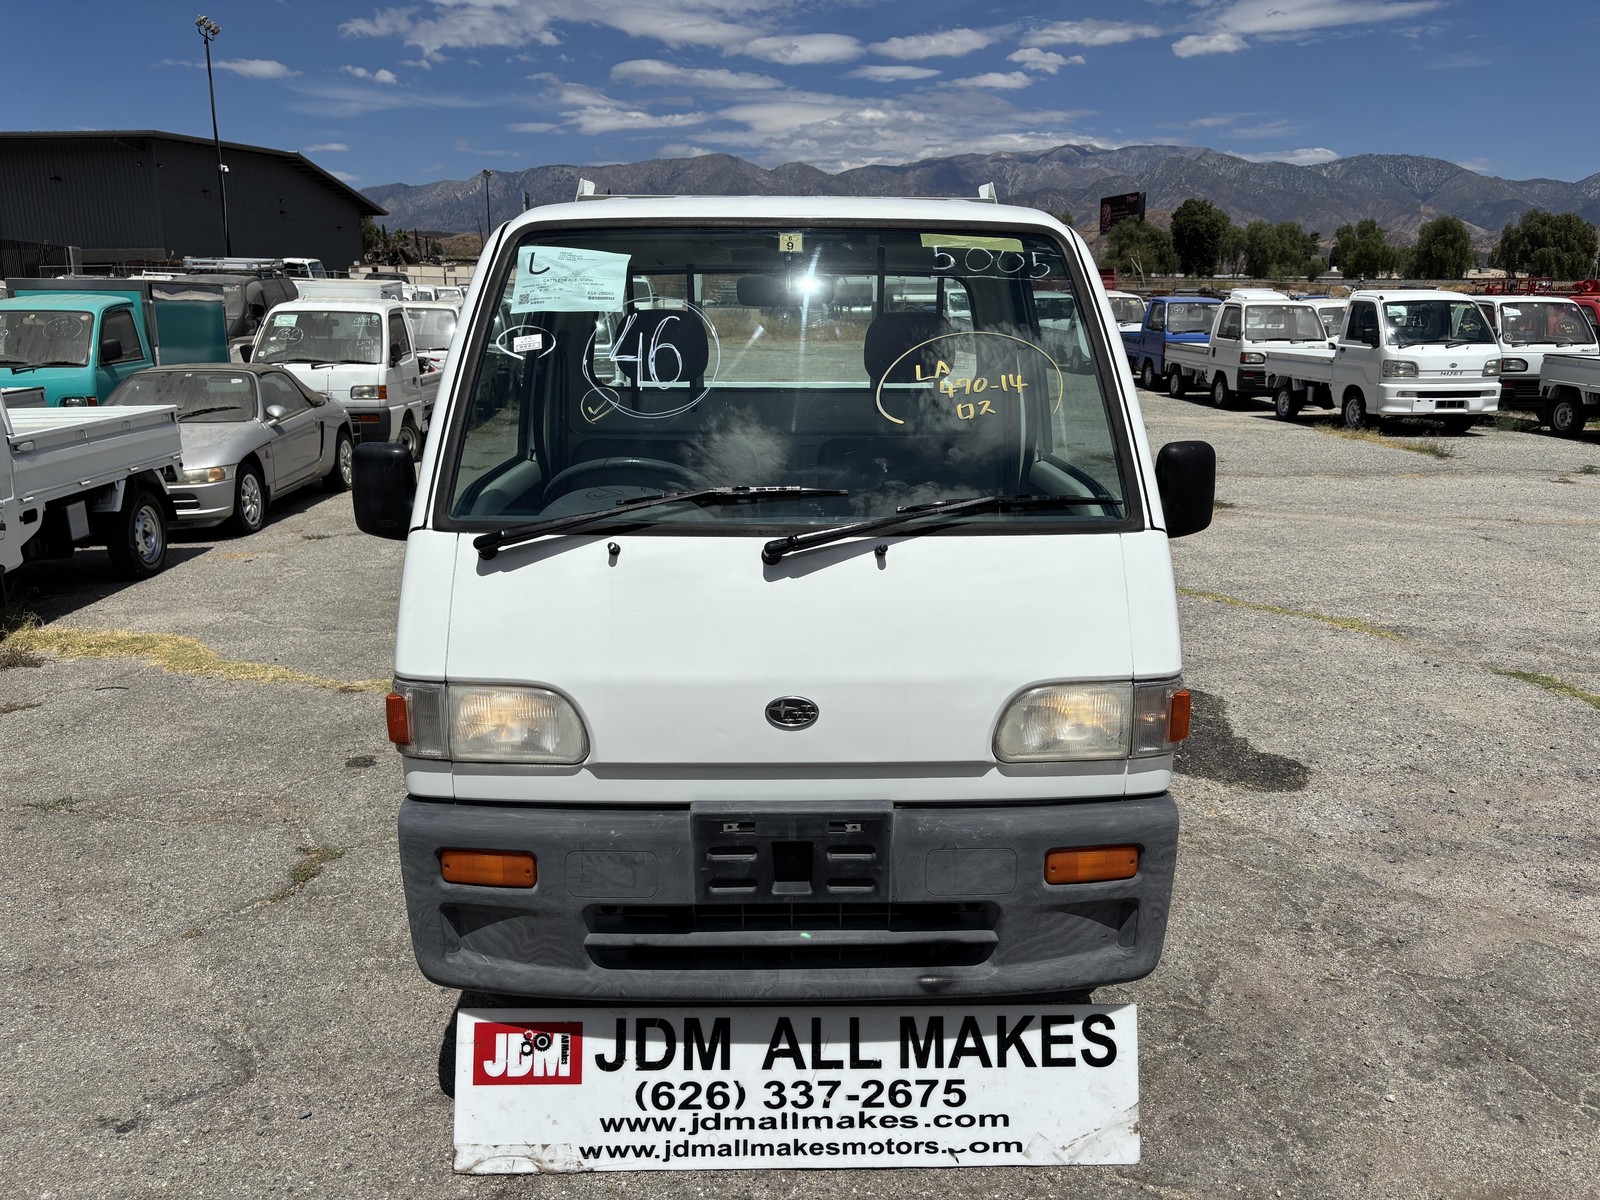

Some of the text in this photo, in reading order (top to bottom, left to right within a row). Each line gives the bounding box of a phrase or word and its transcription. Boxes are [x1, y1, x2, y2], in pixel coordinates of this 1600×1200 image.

[786, 241, 794, 250] 9
[932, 245, 1062, 277] 5005
[279, 328, 300, 340] 32
[609, 313, 683, 391] 46
[915, 360, 951, 382] LA
[939, 373, 1028, 398] 470-14
[483, 1033, 571, 1077] JDM
[595, 1013, 1117, 1072] JDM ALL MAKES
[635, 1079, 967, 1111] (626) 337-2675
[599, 1111, 1010, 1135] www.jdmallmakes.com
